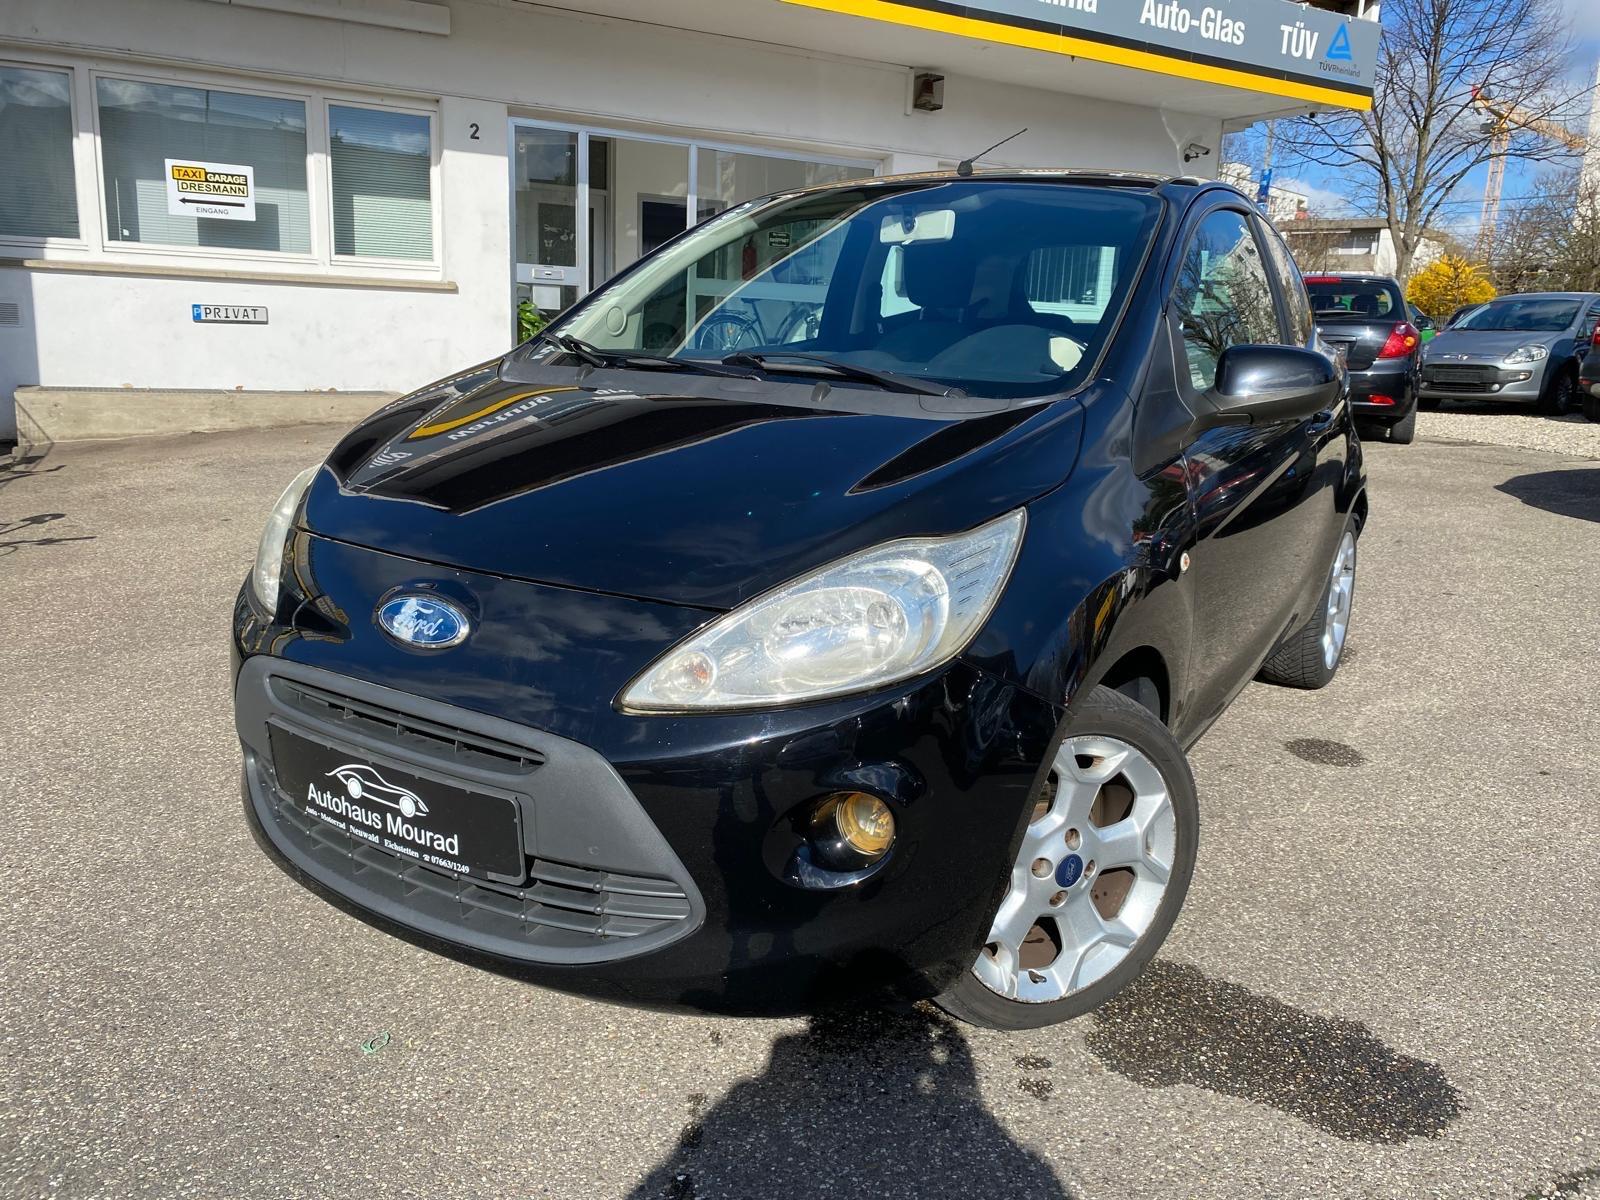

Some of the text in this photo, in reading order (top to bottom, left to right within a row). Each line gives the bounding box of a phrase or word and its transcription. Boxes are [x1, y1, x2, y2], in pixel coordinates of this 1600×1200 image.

[1139, 0, 1245, 45] Auto-Glas
[1280, 21, 1319, 60] TÜV
[469, 122, 480, 140] 2
[175, 168, 247, 184] TAXI GARAGE
[180, 182, 246, 195] DRESMANN
[196, 207, 229, 215] EINGANG
[193, 307, 259, 319] P PRIVAT
[307, 782, 459, 856] Autohaus Mourad
[320, 812, 346, 830] Motorrad
[349, 824, 380, 844] Neuwald
[384, 838, 419, 858] Eichstetten
[431, 855, 470, 874] 07663/1249
